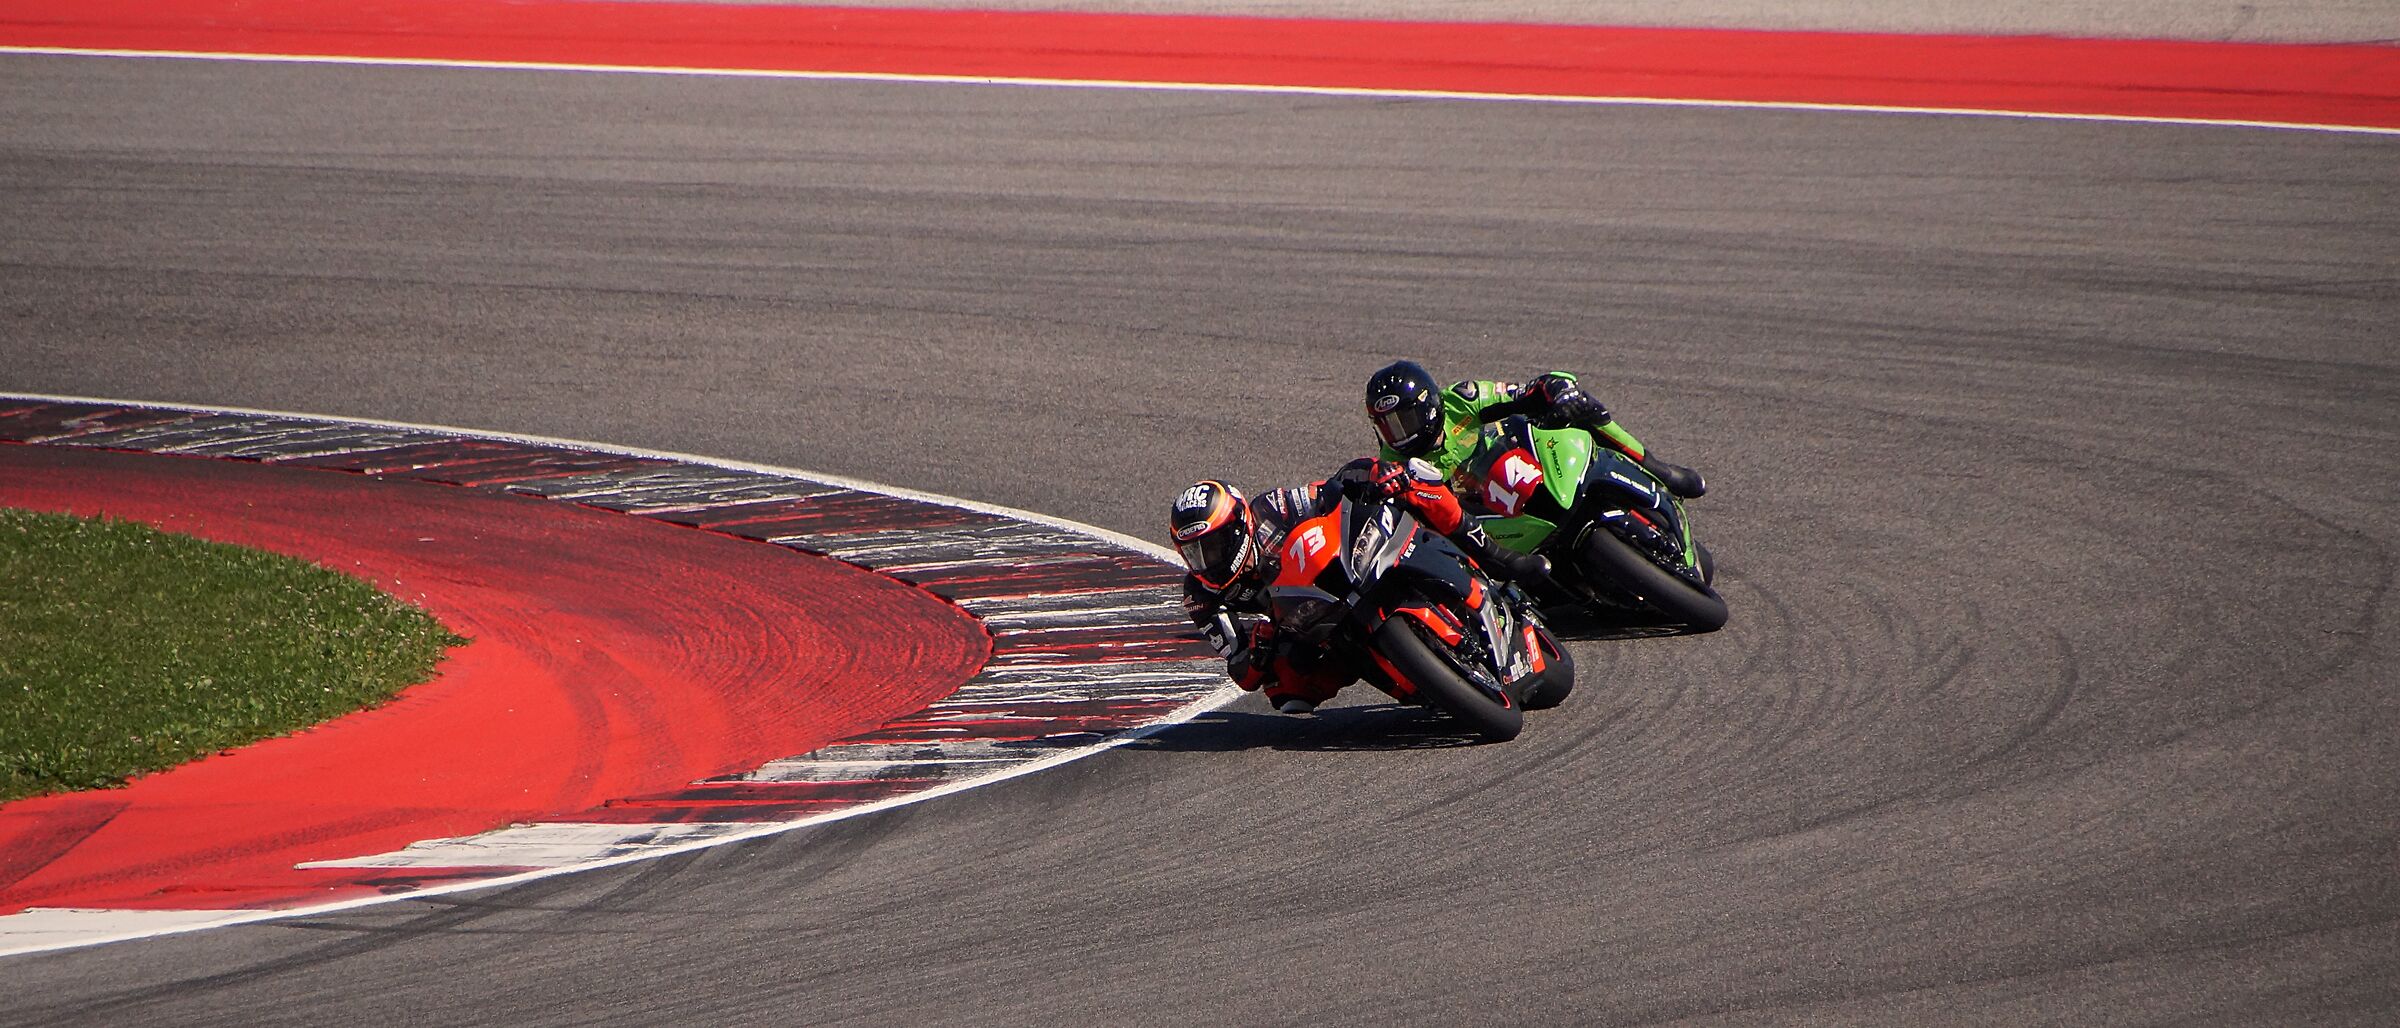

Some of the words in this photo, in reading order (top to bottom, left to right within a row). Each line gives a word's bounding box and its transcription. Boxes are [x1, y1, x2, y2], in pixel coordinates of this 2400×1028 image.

[1378, 396, 1397, 408] Arai
[1488, 455, 1542, 515] 14
[1290, 525, 1326, 573] 73
